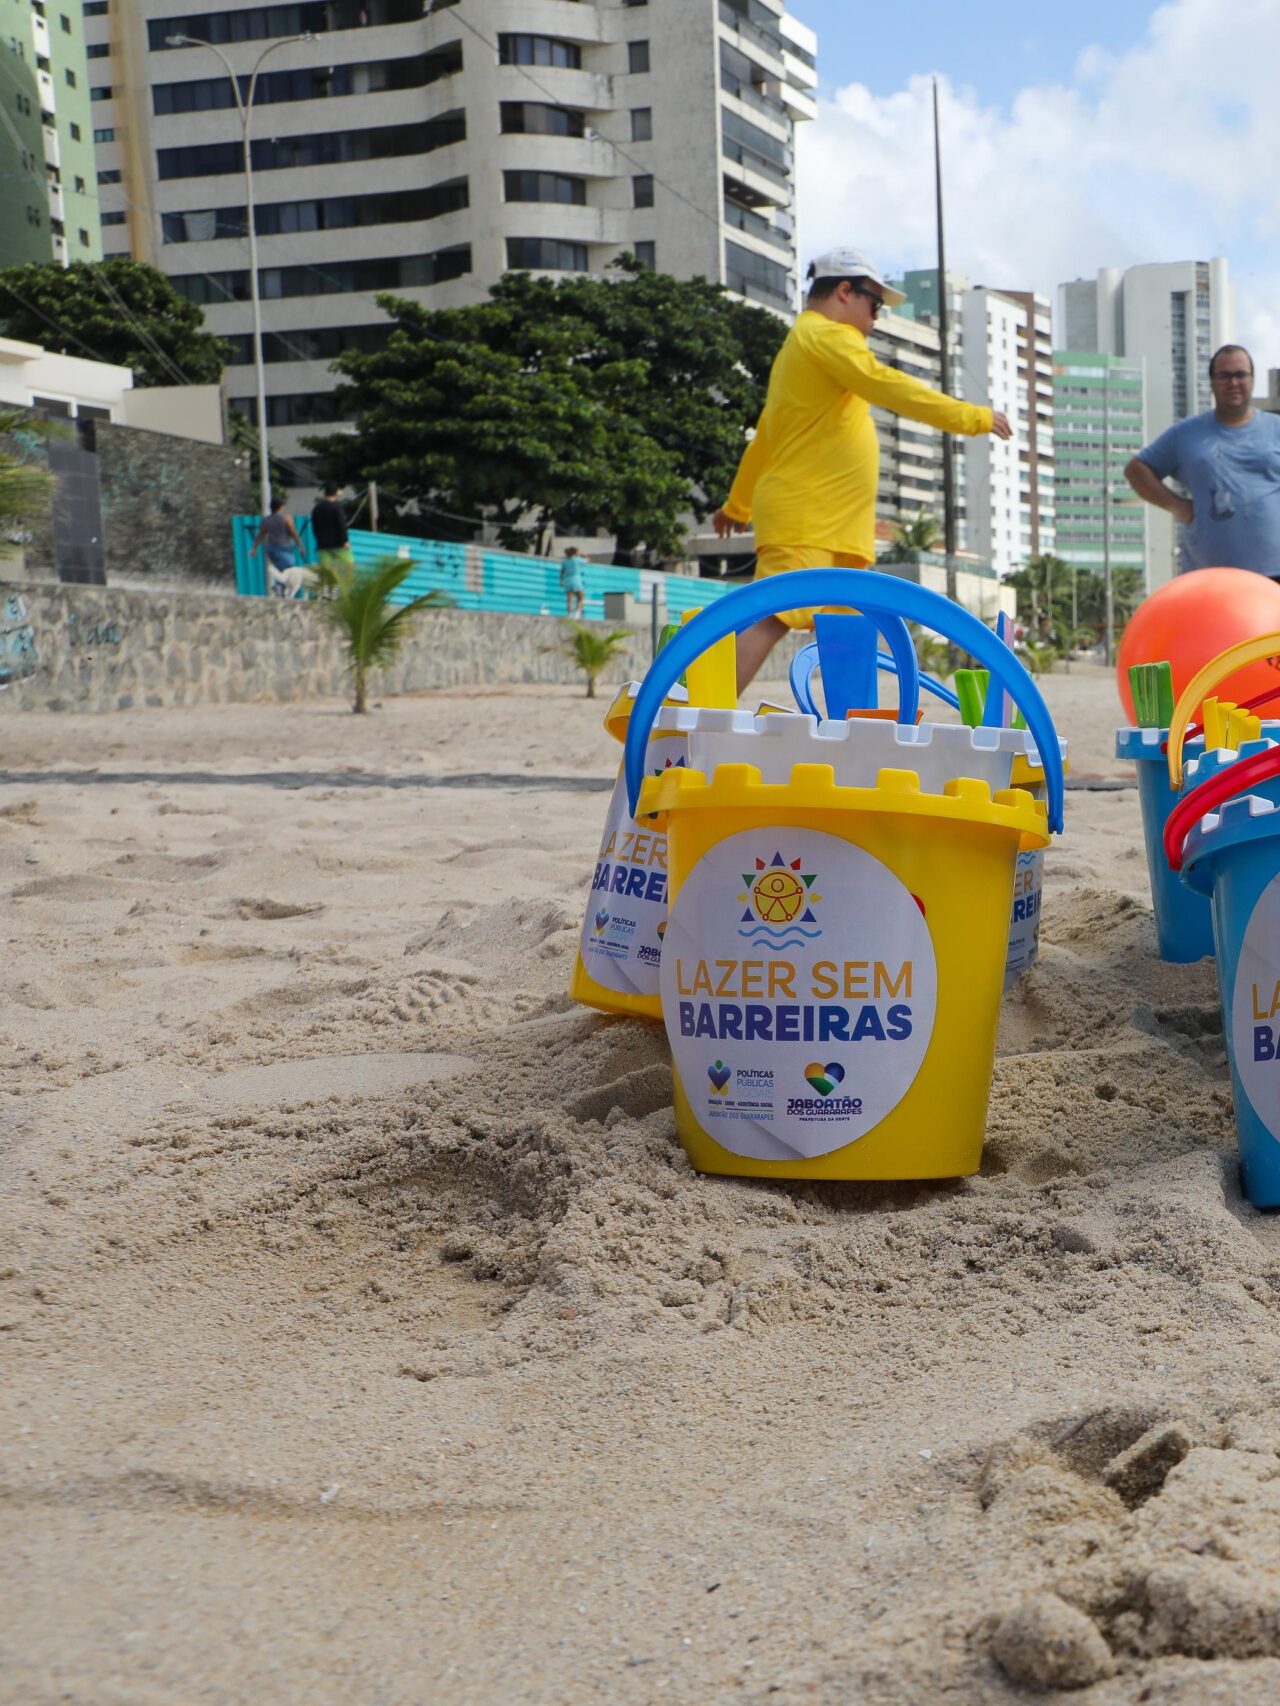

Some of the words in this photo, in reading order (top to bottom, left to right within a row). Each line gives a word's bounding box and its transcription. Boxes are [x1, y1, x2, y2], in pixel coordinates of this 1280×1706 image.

[677, 959, 797, 999] LAZER
[811, 960, 913, 999] SEM
[679, 1001, 913, 1042] BARREIRAS
[737, 1068, 774, 1078] POLÍTICAS
[737, 1077, 774, 1088] PÚBLICAS
[787, 1096, 862, 1109] JABOATÃO
[787, 1108, 804, 1116] DOS
[806, 1108, 862, 1116] GUARARAPES
